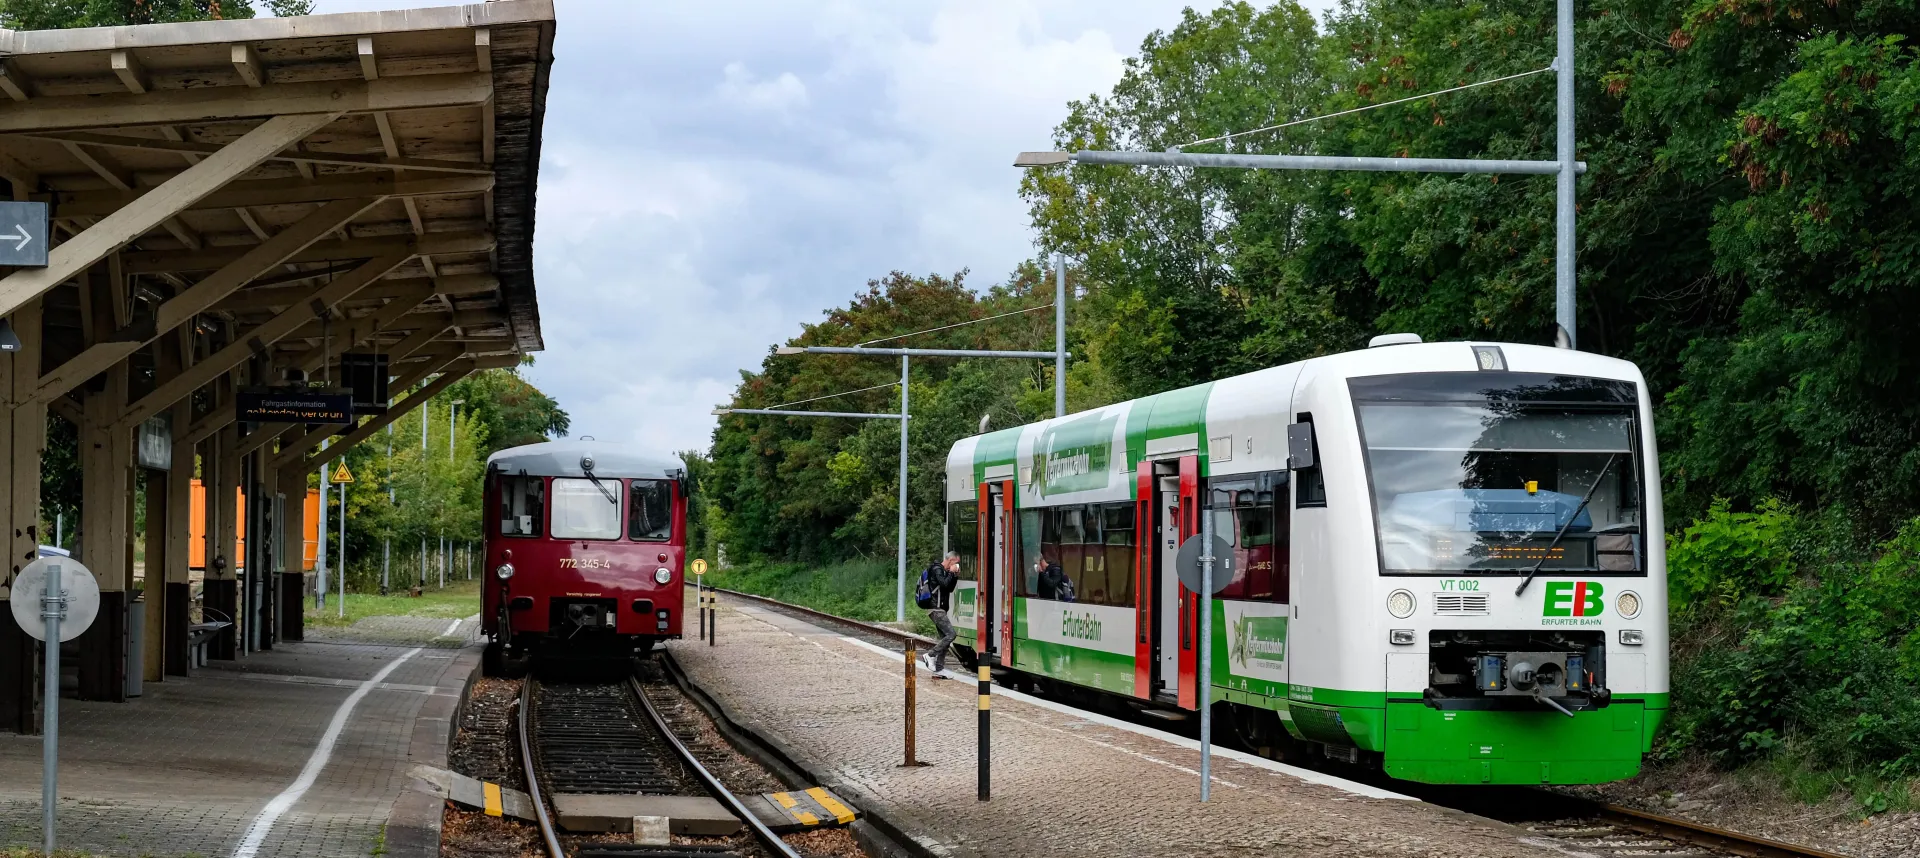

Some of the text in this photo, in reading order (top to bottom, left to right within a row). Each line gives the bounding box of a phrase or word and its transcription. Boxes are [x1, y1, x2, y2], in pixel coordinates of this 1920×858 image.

[261, 400, 327, 408] Fahrgastinformation
[560, 558, 611, 569] 772 345-4
[1440, 580, 1479, 591] VT 002
[1063, 610, 1102, 641] ErfurterBahn
